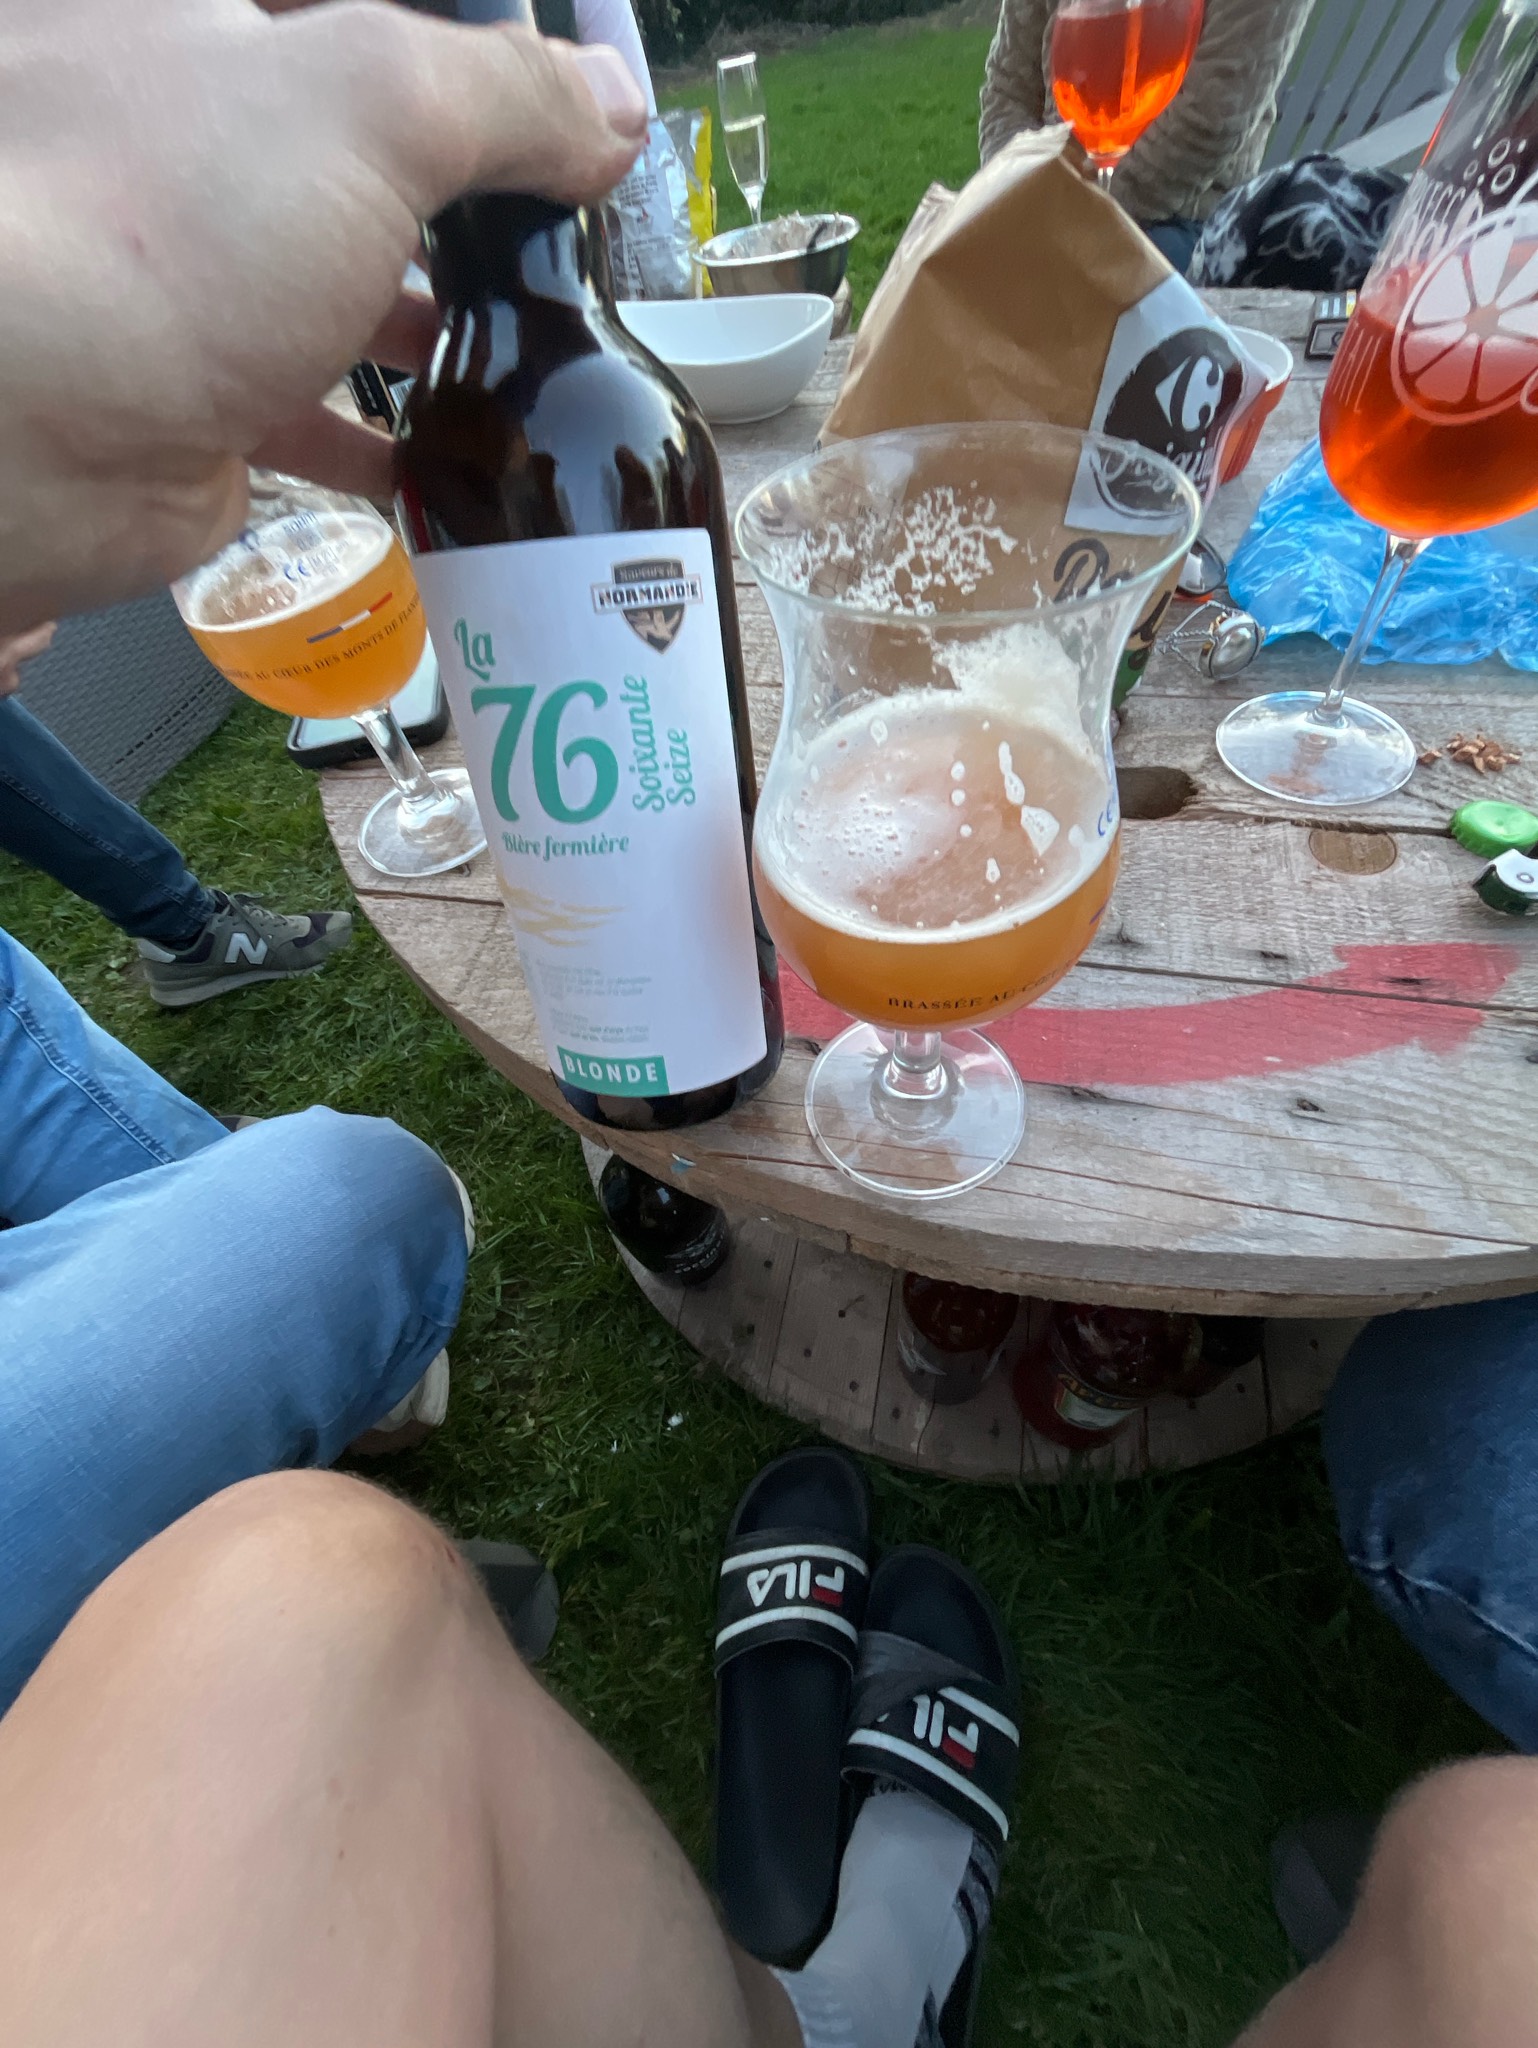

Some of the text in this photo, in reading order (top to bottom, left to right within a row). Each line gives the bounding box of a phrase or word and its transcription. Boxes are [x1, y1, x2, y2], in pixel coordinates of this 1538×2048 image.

[599, 581, 699, 606] NORMANDIE
[314, 653, 342, 670] DES
[343, 629, 385, 661] MONTS
[385, 618, 399, 638] DE
[454, 617, 495, 682] La
[470, 680, 619, 825] 76
[620, 673, 666, 814] Soixante
[666, 728, 696, 808] Seize
[501, 831, 630, 863] Bière fermière
[225, 933, 268, 964] N
[888, 996, 984, 1011] BRASSÉE
[563, 1054, 658, 1084] BLONDE
[746, 1559, 845, 1608] FILA
[877, 1693, 980, 1771] FIL
